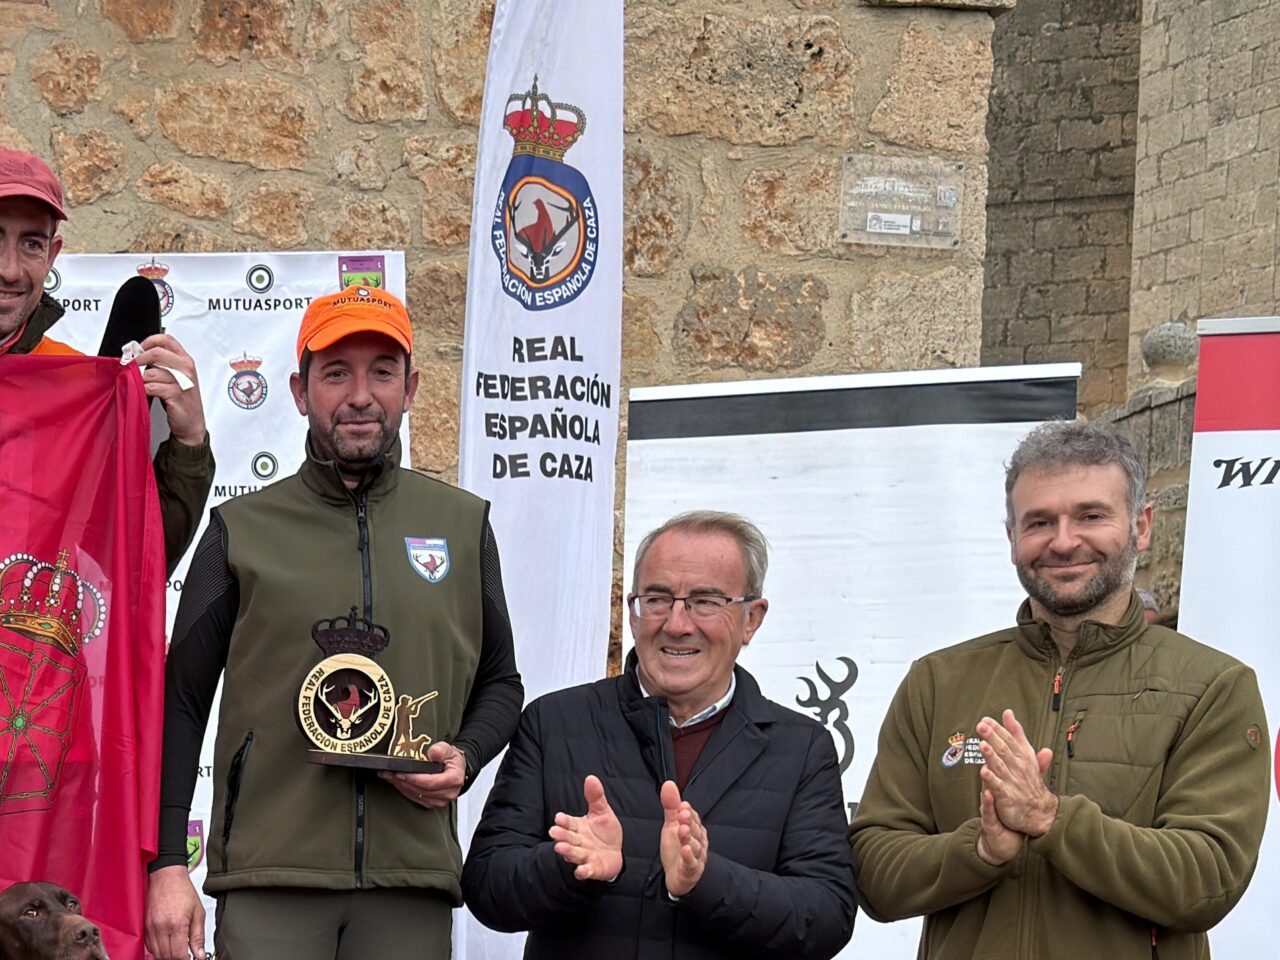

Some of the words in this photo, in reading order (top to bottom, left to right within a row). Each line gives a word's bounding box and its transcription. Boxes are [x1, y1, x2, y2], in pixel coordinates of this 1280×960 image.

[583, 196, 597, 238] CAZA
[585, 243, 596, 263] DE
[535, 264, 591, 306] ESPAÑOLA
[208, 298, 312, 311] MUTUASPORT
[332, 297, 392, 309] MUTUASPORT
[513, 336, 584, 363] REAL
[476, 371, 611, 408] FEDERACIÓN
[485, 407, 600, 445] ESPAÑOLA
[493, 453, 530, 479] DE
[540, 452, 593, 482] CAZA
[304, 667, 325, 692] REAL
[377, 675, 392, 703] CAZA
[302, 696, 338, 752] FEDERACIÓN
[383, 706, 392, 721] DE
[340, 723, 387, 753] ESPAÑOLA
